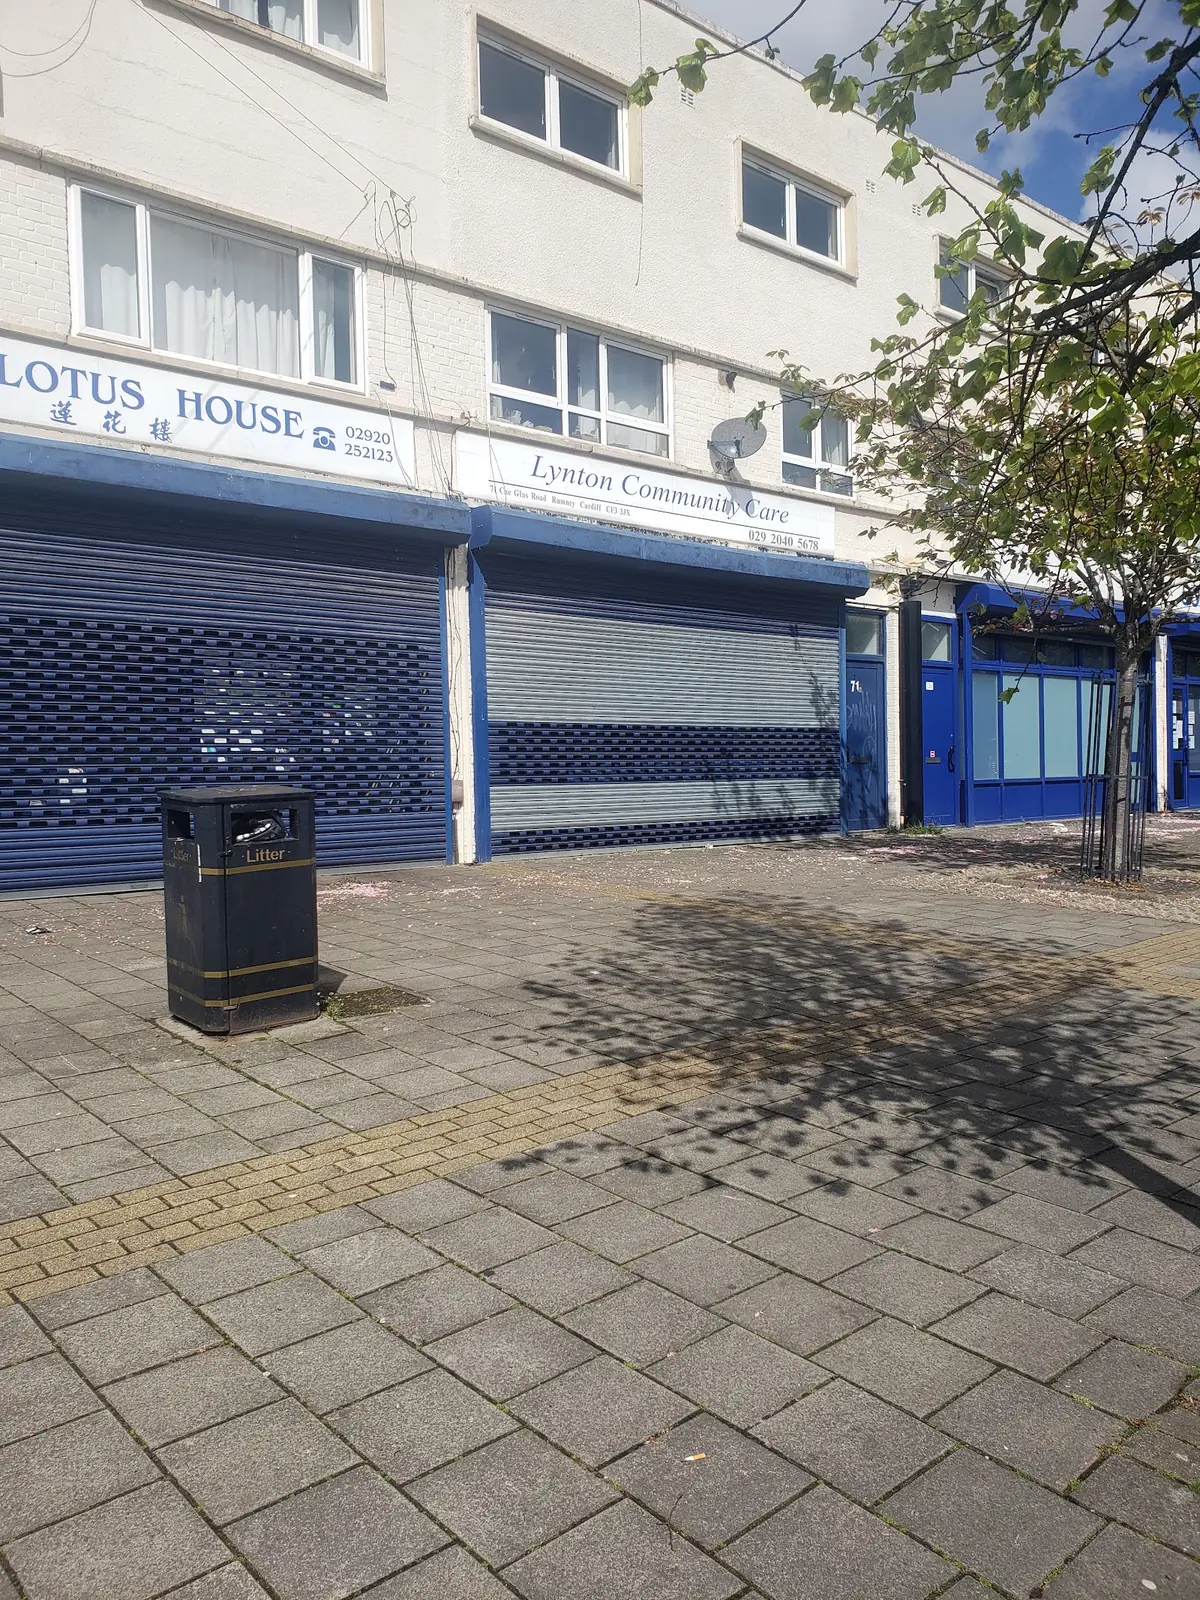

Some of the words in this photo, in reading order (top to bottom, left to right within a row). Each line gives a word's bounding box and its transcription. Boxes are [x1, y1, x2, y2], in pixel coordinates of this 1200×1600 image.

[0, 353, 145, 410] LOTUS
[176, 388, 304, 439] HOUSE
[345, 426, 391, 445] 02920
[344, 443, 393, 463] 252123
[530, 455, 613, 491] Lynton
[621, 474, 741, 520] Community
[745, 498, 790, 524] Care
[513, 489, 529, 499] Glas
[531, 492, 547, 502] Road
[551, 495, 576, 508] Rumney
[579, 500, 602, 512] Cardiff
[605, 505, 618, 515] CF3
[748, 529, 767, 542] 029
[770, 534, 793, 547] 2040
[797, 538, 819, 551] 5678
[246, 849, 285, 863] Litter
